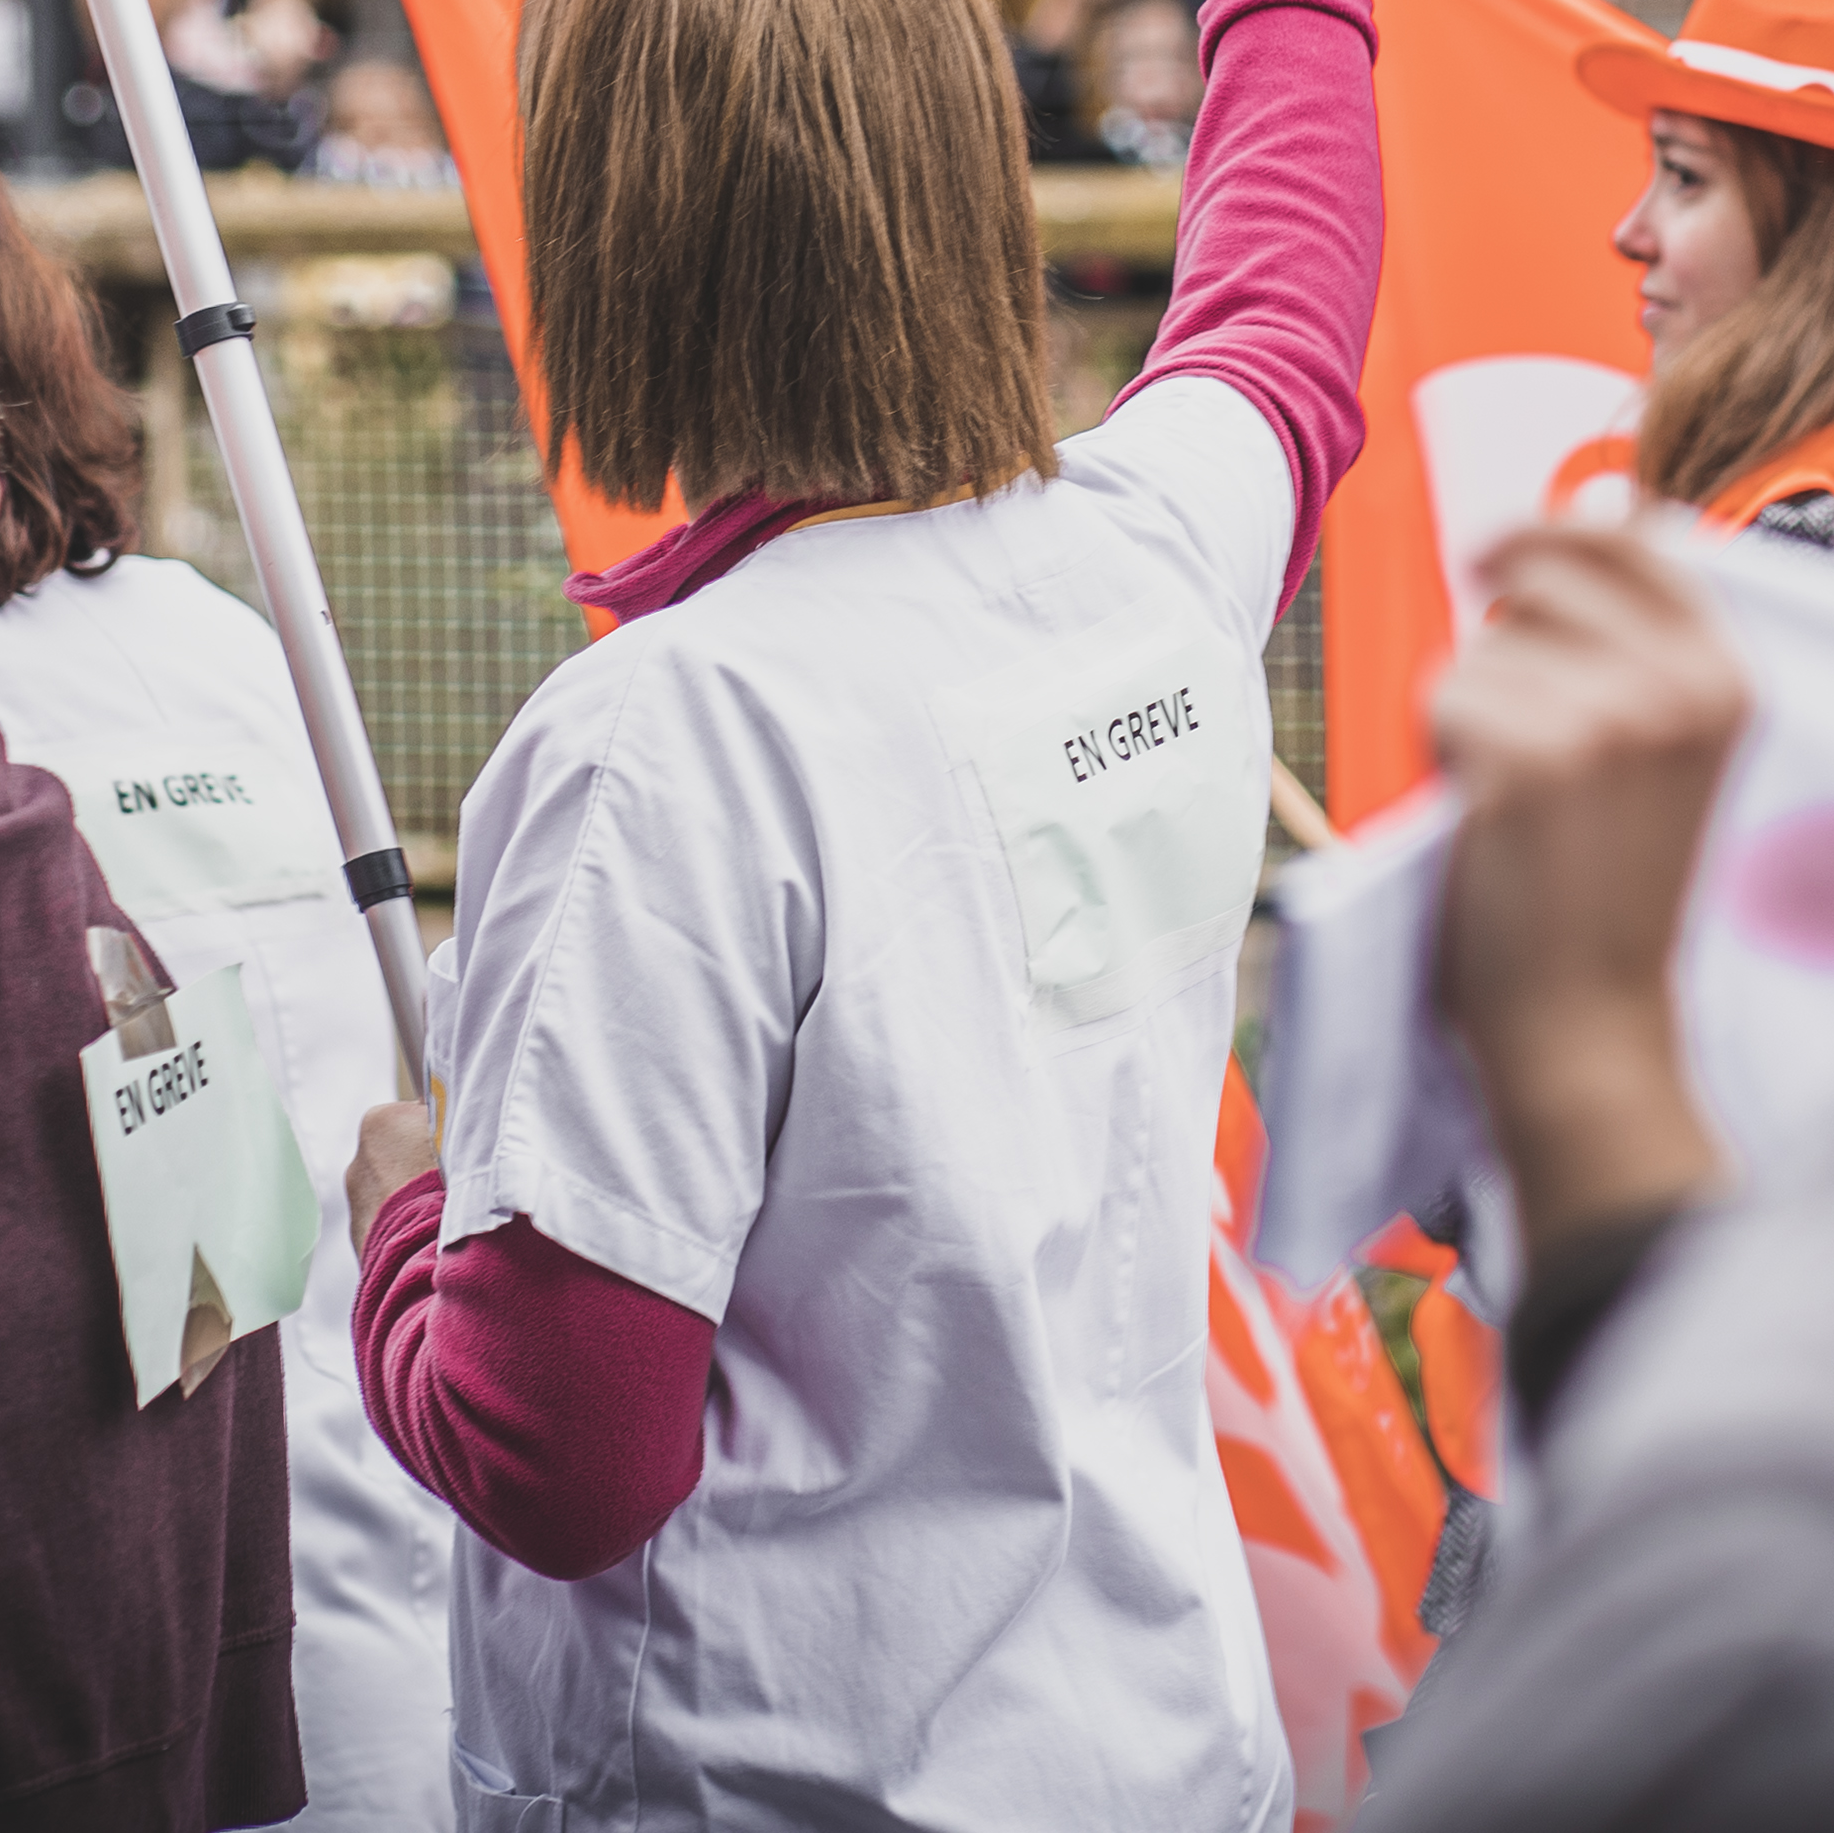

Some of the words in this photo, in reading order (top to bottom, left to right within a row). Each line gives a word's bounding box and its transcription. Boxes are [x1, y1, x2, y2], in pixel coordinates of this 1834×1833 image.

[1063, 730, 1107, 783] EN
[1107, 686, 1200, 762] GREVE
[113, 780, 159, 814] EN
[163, 772, 254, 807] GREVE
[113, 1078, 147, 1137] EN
[147, 1039, 209, 1117] GREVE
